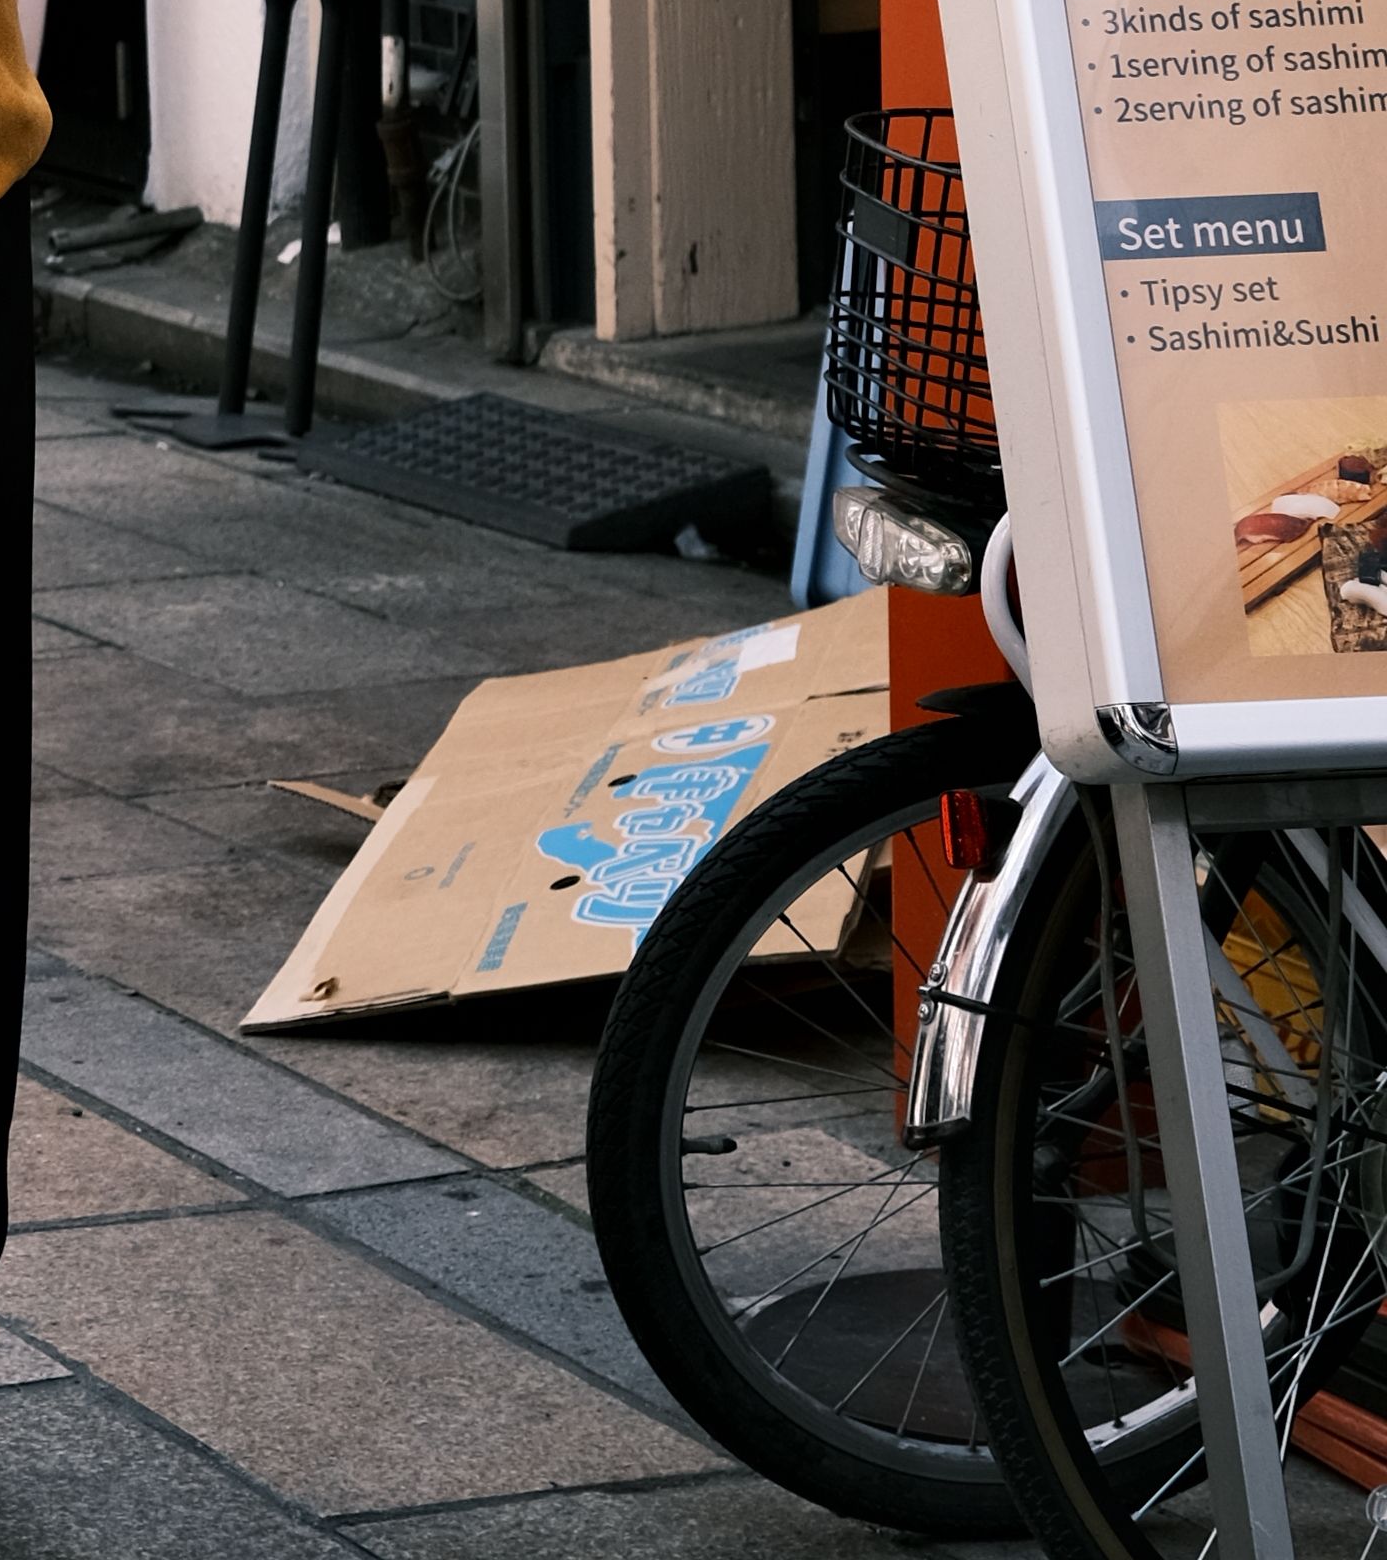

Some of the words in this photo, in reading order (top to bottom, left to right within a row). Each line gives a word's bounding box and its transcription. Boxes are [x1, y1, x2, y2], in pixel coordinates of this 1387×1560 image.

[1102, 5, 1203, 34] 3kinds
[1211, 3, 1240, 30] of
[1110, 49, 1239, 81] 1serving
[1246, 45, 1275, 73] of
[1114, 93, 1246, 125] 2serving
[1253, 89, 1281, 117] of
[1119, 218, 1183, 250] Set
[1193, 219, 1303, 246] menu
[1140, 279, 1223, 312] Tipsy
[1233, 277, 1280, 302] set
[1149, 315, 1379, 352] Sashimi&Sushi
